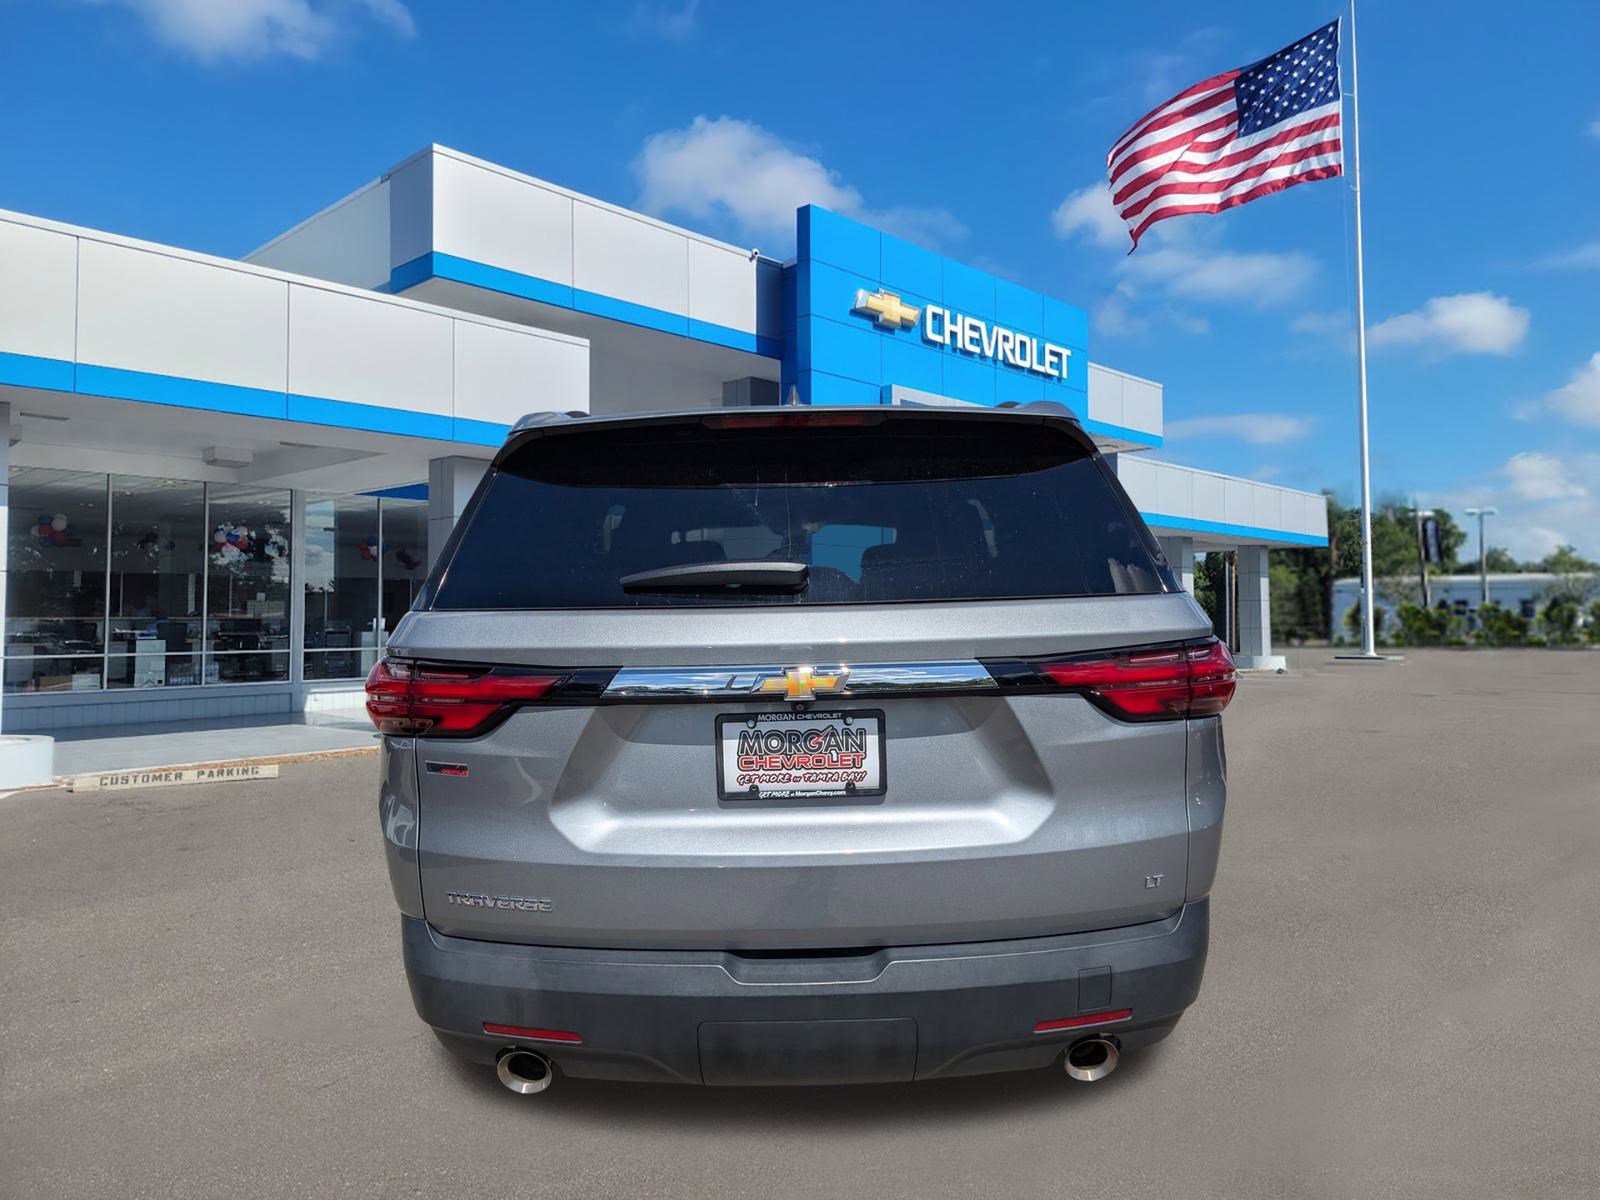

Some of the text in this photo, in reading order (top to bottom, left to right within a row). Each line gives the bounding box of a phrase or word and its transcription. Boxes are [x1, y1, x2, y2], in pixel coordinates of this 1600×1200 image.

[925, 304, 1072, 379] CHEVROLET
[738, 726, 866, 755] MORGAN
[738, 753, 865, 770] CHEVROLET
[100, 766, 260, 787] CUSTOMER PARKING
[737, 774, 759, 785] GET
[760, 772, 791, 784] MORE
[804, 772, 840, 783] TAMPA
[841, 771, 867, 783] BAY!
[795, 790, 846, 798] MorganChevy.com
[1145, 873, 1165, 889] LT
[446, 890, 552, 912] TRAVERSE
